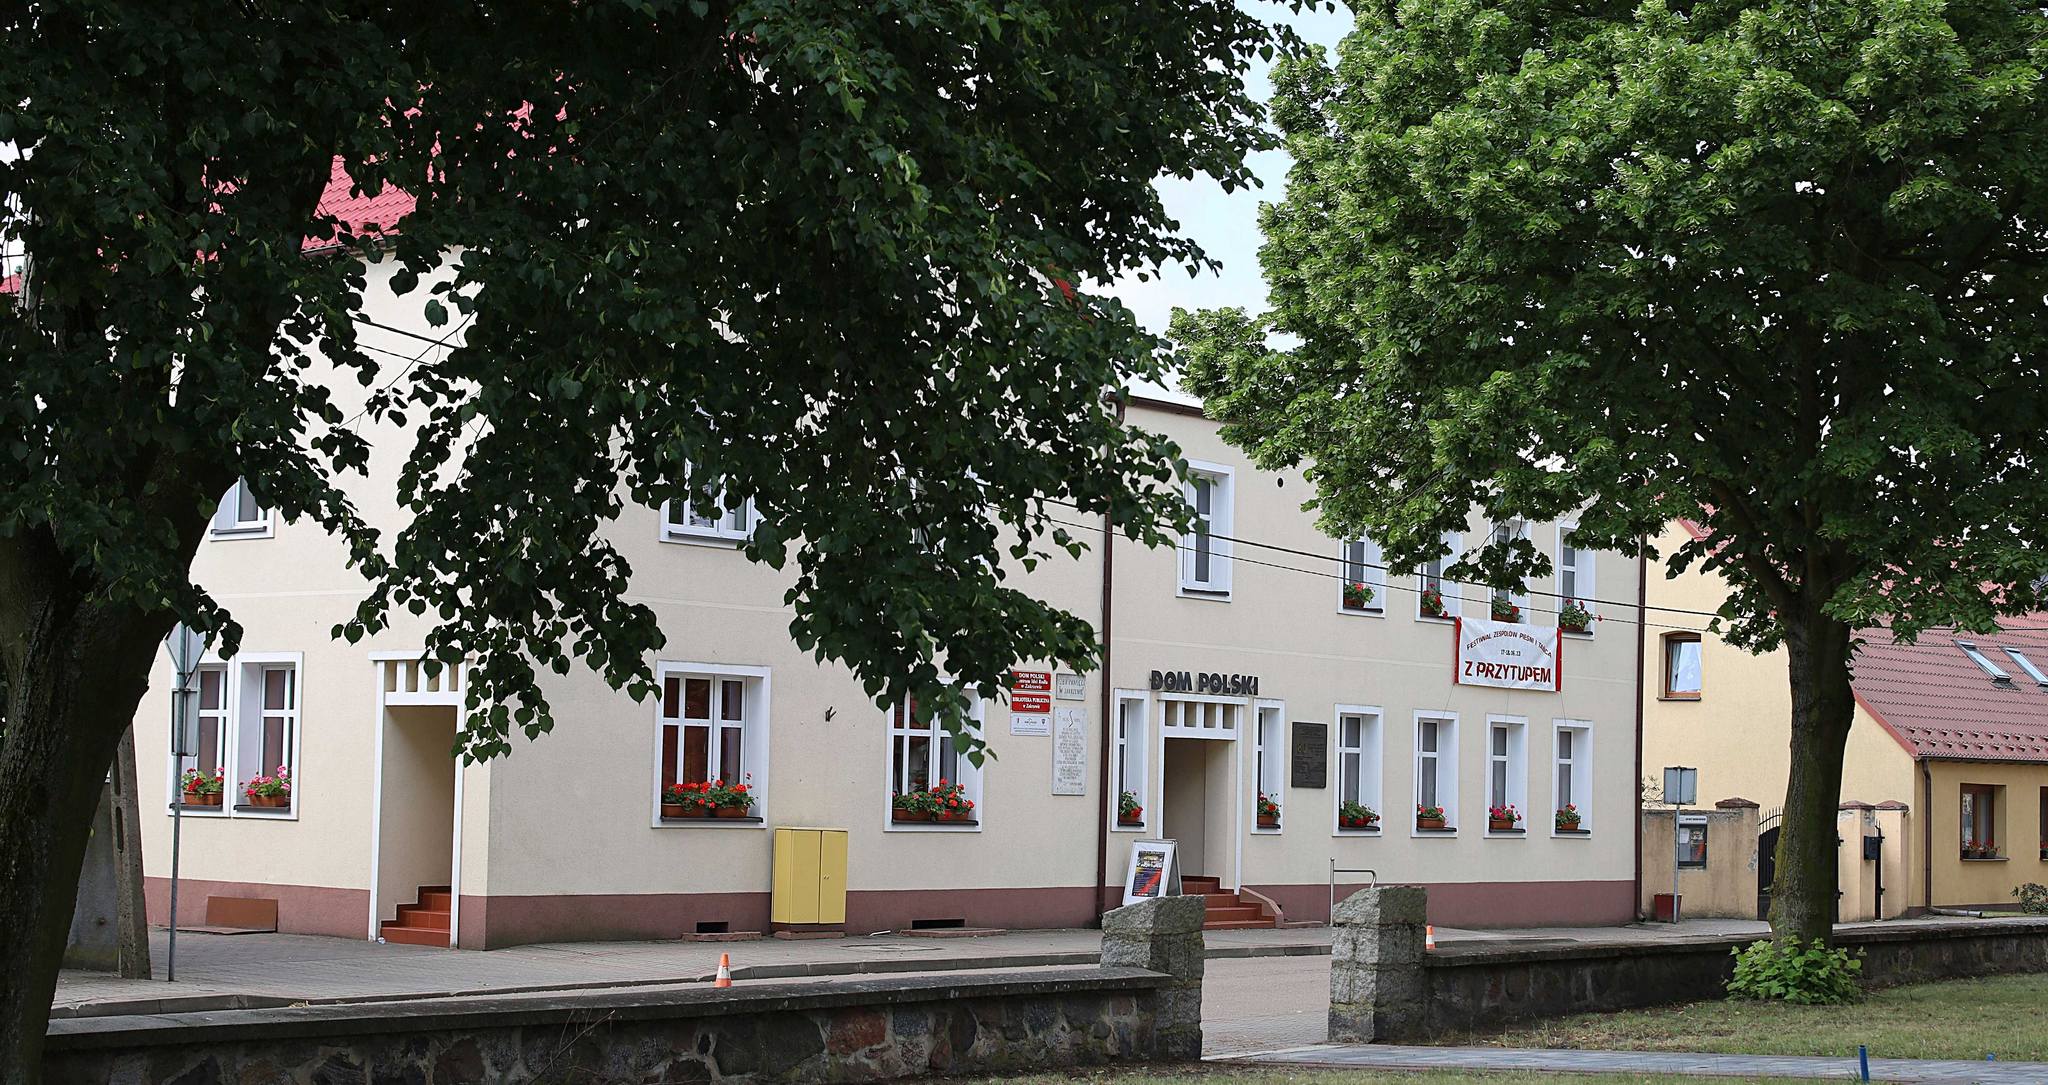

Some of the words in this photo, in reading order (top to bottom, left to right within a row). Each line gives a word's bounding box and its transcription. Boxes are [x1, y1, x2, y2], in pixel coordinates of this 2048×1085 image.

[1467, 633, 1491, 651] FESTIWAL
[1151, 670, 1193, 691] DOM
[1198, 672, 1259, 696] POLSKI
[1465, 660, 1473, 676] Z
[1476, 661, 1551, 683] PRZYTUPEM
